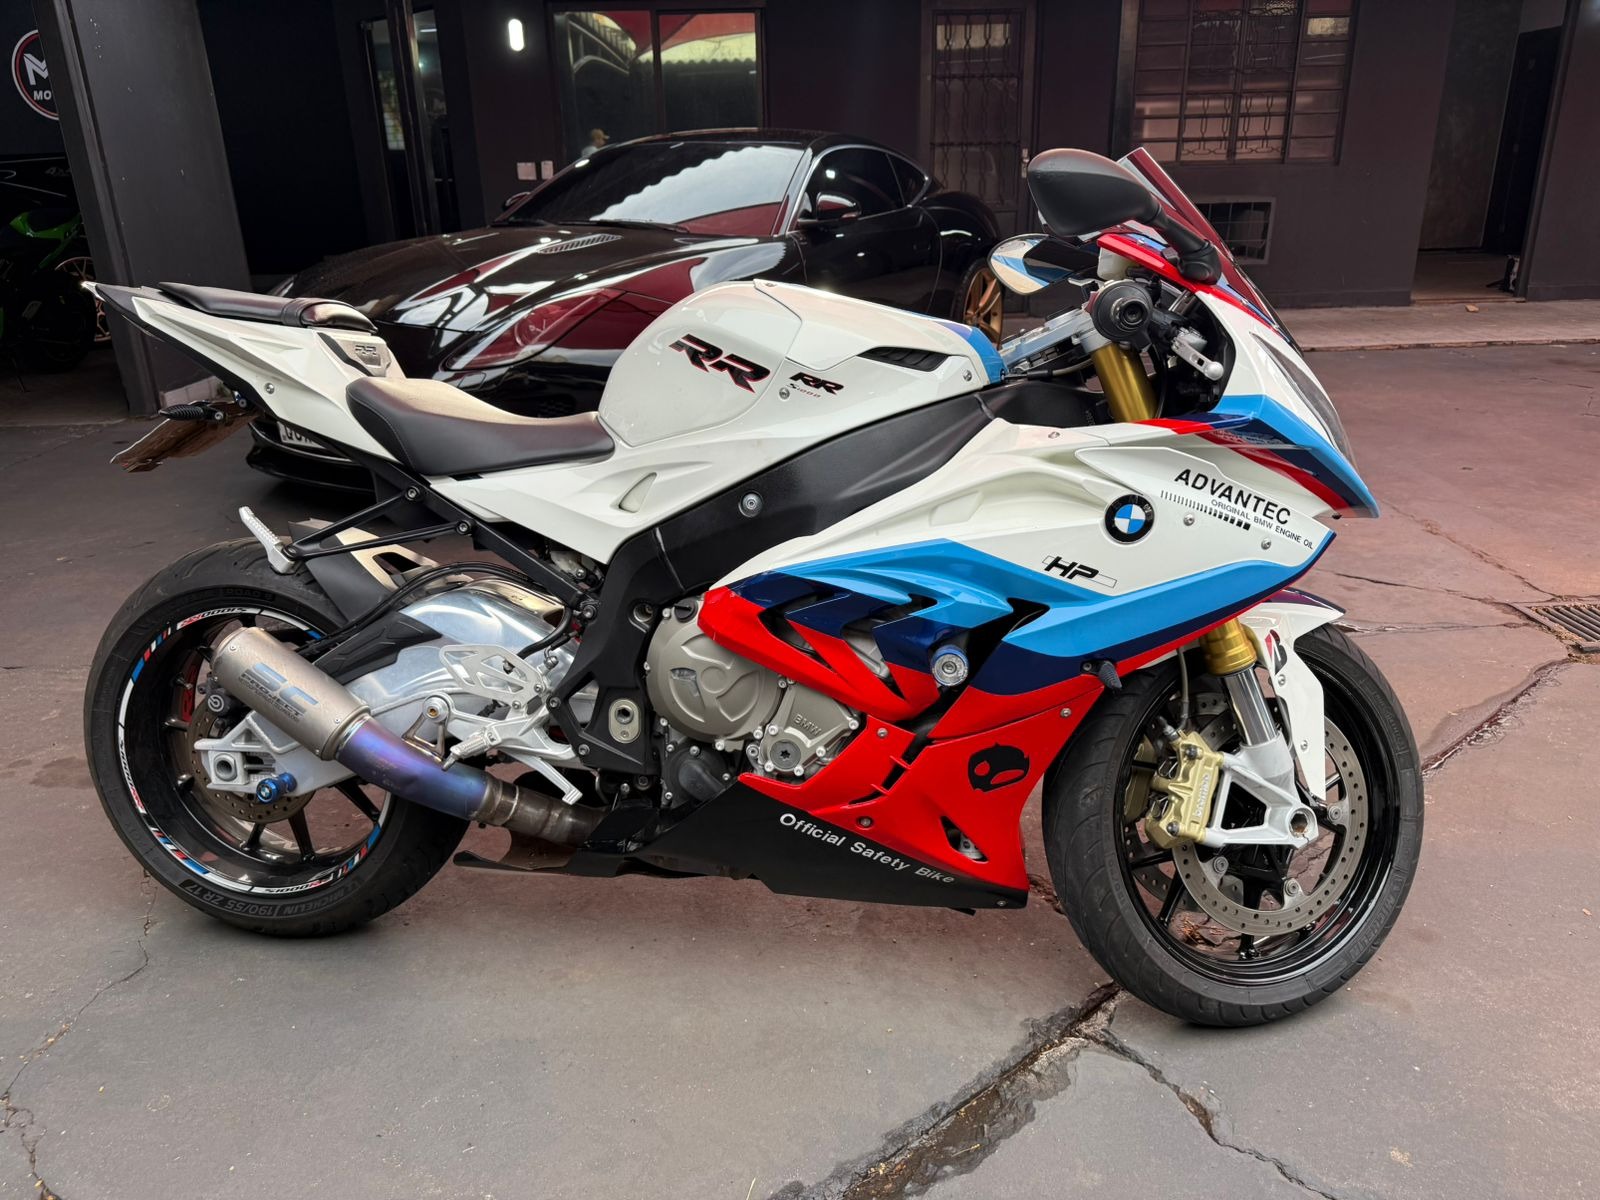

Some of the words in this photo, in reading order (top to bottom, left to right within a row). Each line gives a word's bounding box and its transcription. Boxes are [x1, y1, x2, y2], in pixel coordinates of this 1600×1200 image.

[33, 89, 53, 101] MO
[668, 333, 771, 394] RR
[789, 371, 845, 396] RR
[1174, 468, 1291, 525] ADVANTEC
[1211, 498, 1250, 520] ORIGINAL
[1253, 515, 1273, 530] BMW
[1275, 525, 1302, 543] ENGINE
[1303, 538, 1314, 550] OIL
[1044, 555, 1099, 580] HP
[239, 672, 302, 718] PROJECT
[793, 712, 823, 737] BMW
[779, 812, 847, 847] Official
[850, 841, 910, 871] Safety
[914, 866, 956, 884] Bike
[185, 883, 203, 895] 17
[202, 889, 225, 905] ZR
[283, 886, 345, 914] MICHELIN
[225, 899, 273, 916] 190/55
